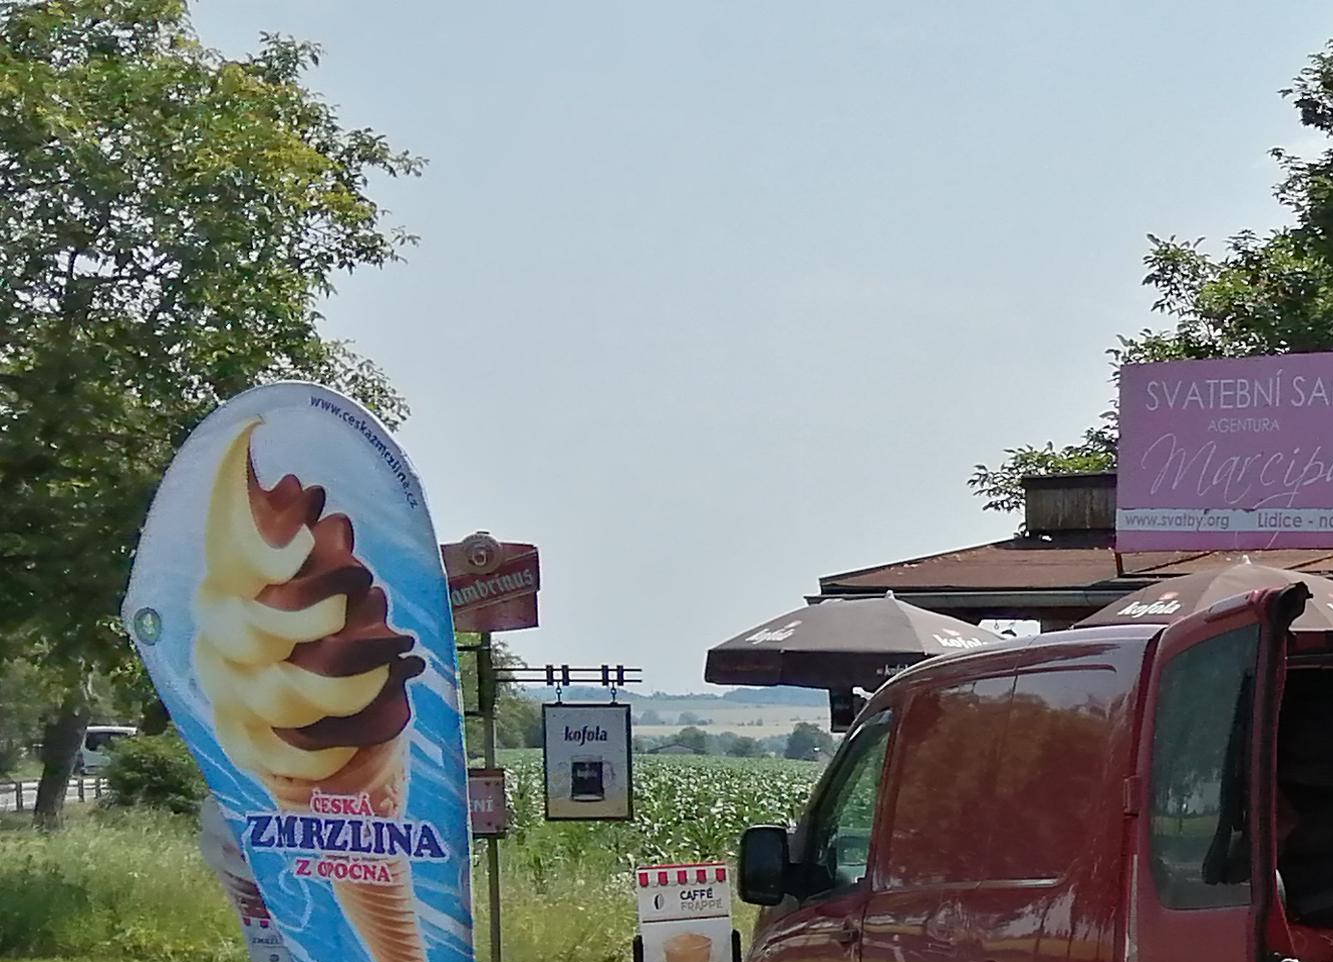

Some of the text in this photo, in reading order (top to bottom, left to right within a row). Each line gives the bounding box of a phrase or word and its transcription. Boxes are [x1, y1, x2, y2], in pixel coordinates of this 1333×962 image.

[1145, 369, 1283, 411] SVATEBNÍ
[1207, 417, 1280, 433] AGENTURA
[310, 395, 419, 509] www.ceskazmrzlina.cz
[1125, 512, 1230, 531] www.svatby.org
[1257, 511, 1302, 528] Lidice
[451, 569, 534, 606] ambrinus
[1117, 600, 1182, 618] kofola
[564, 726, 608, 746] kofola
[313, 790, 373, 816] ČESKÁ
[247, 815, 447, 858] ZMRZLINA
[296, 859, 312, 876] Z
